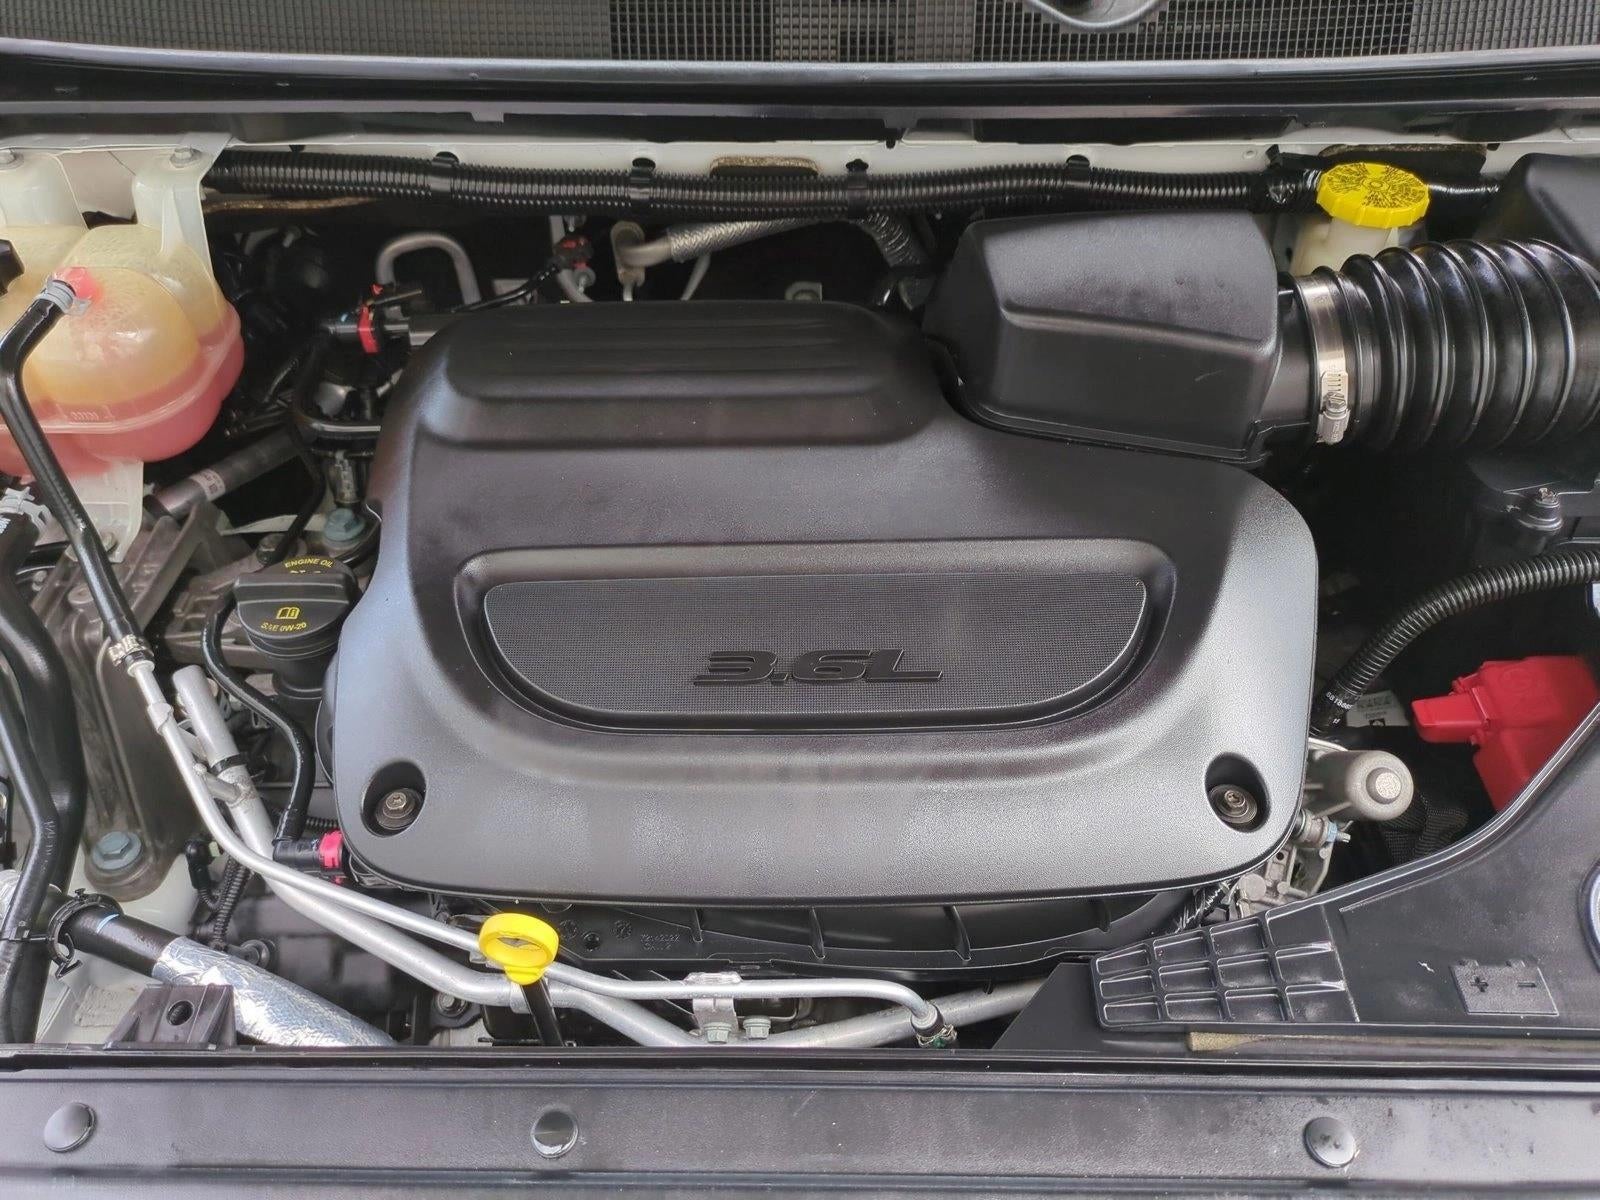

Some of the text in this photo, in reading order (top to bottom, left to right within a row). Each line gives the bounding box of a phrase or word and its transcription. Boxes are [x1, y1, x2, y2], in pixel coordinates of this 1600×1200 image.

[284, 558, 334, 568] ENGINE OIL
[694, 649, 943, 686] 3.6L
